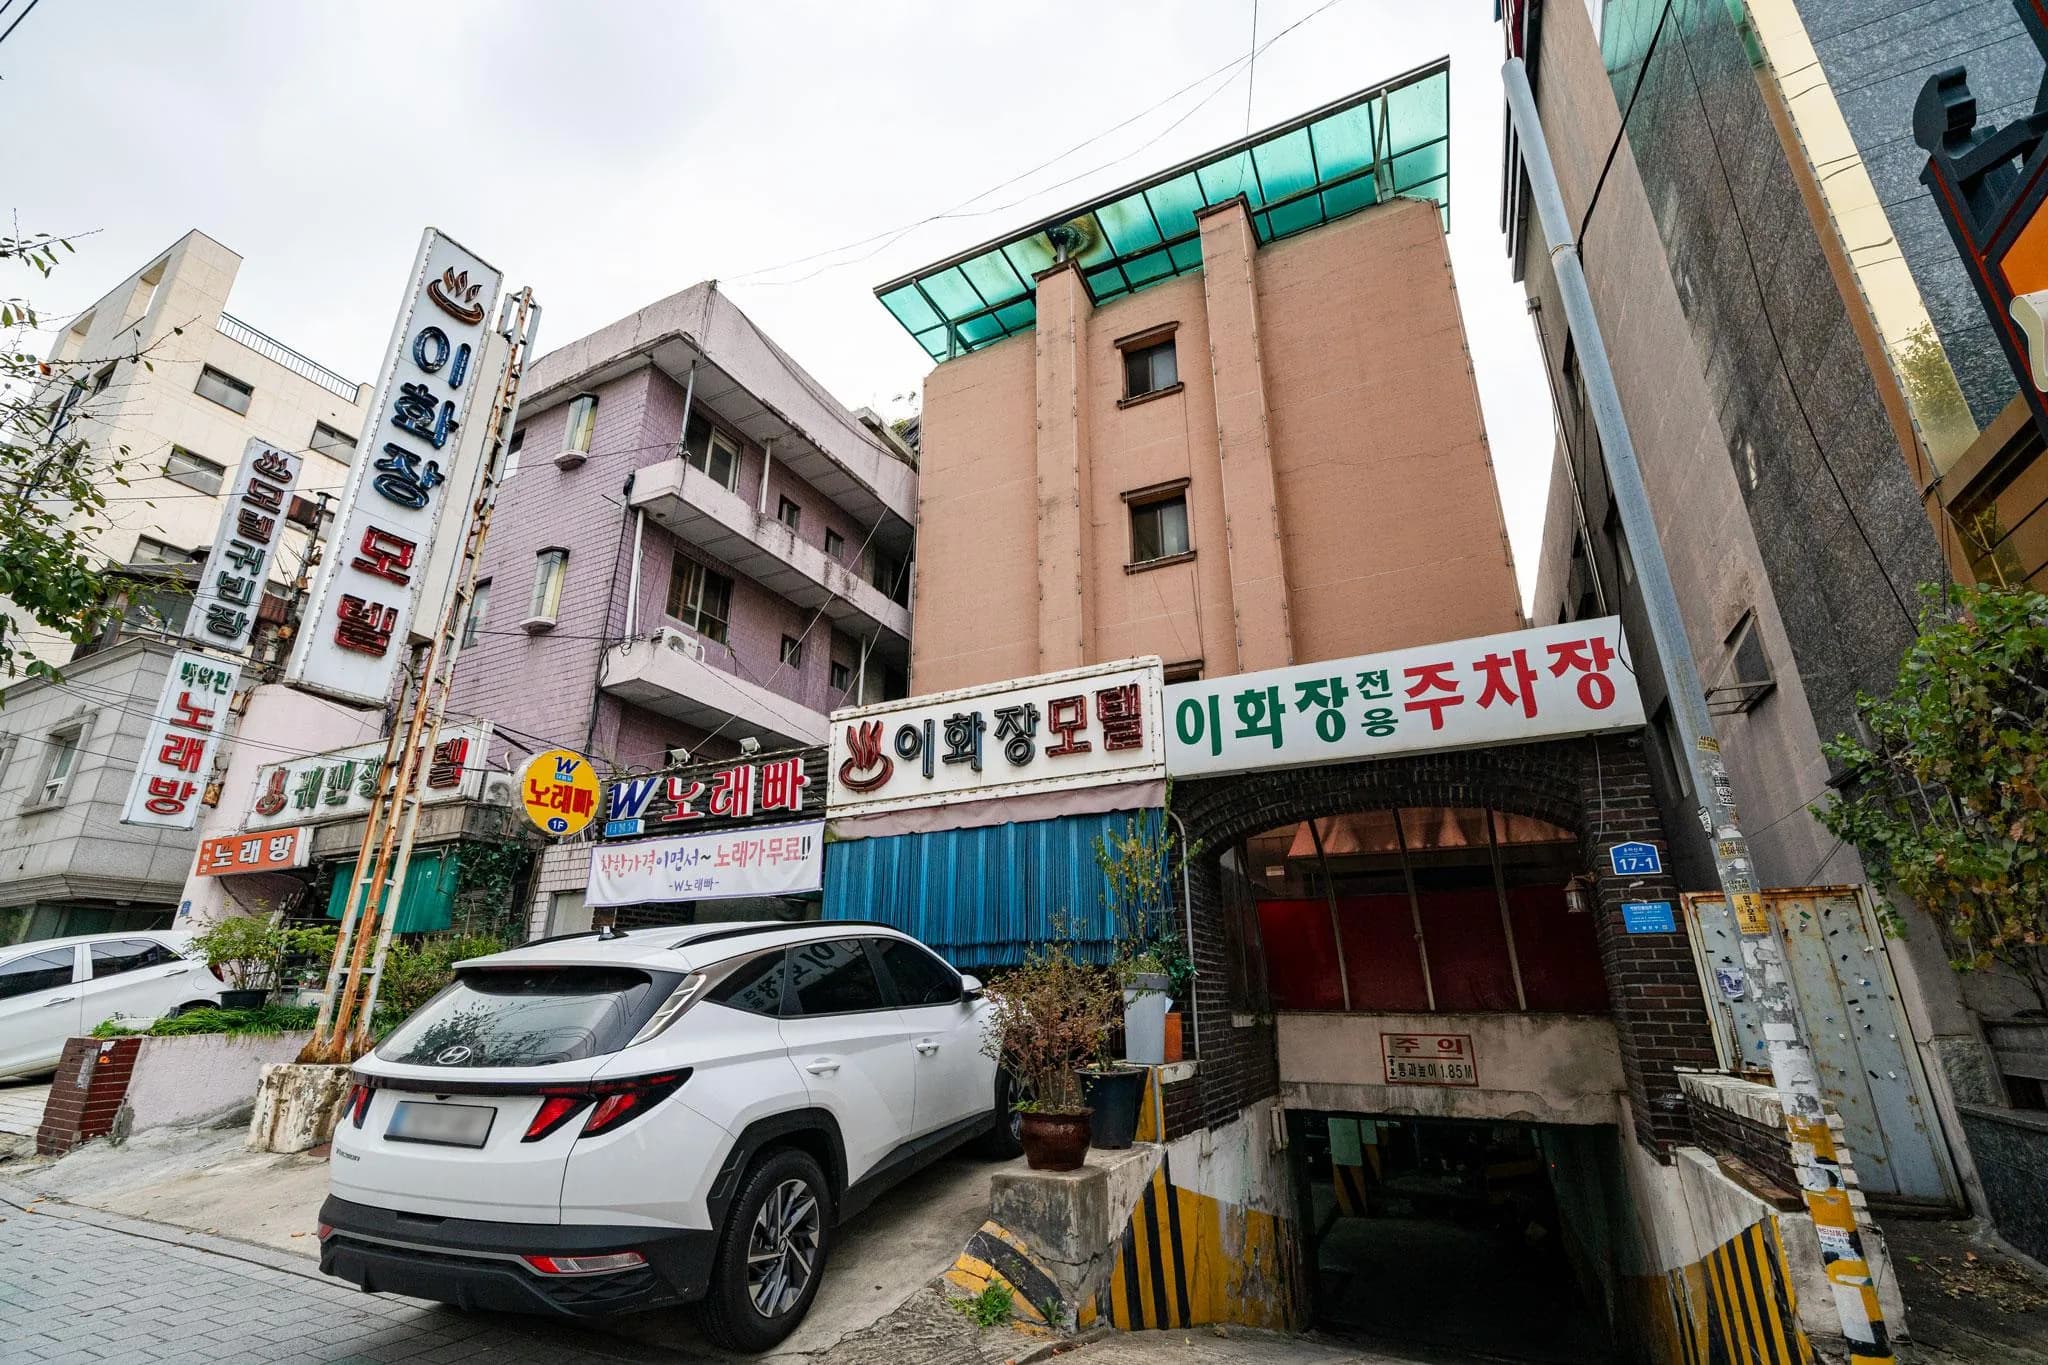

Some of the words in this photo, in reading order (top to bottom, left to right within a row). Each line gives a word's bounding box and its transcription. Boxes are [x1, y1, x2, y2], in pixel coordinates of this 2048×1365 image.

[373, 326, 472, 510] 이화장
[1175, 676, 1349, 757] 이화장
[1404, 636, 1616, 731] 주차장
[145, 692, 214, 815] 노래방
[555, 756, 580, 774] W
[526, 779, 595, 818] 노래빠
[607, 776, 660, 820] W
[661, 758, 810, 822] 노래빠
[552, 820, 565, 830] 1F
[211, 834, 294, 867] 노래방
[1619, 857, 1654, 871] 17-1
